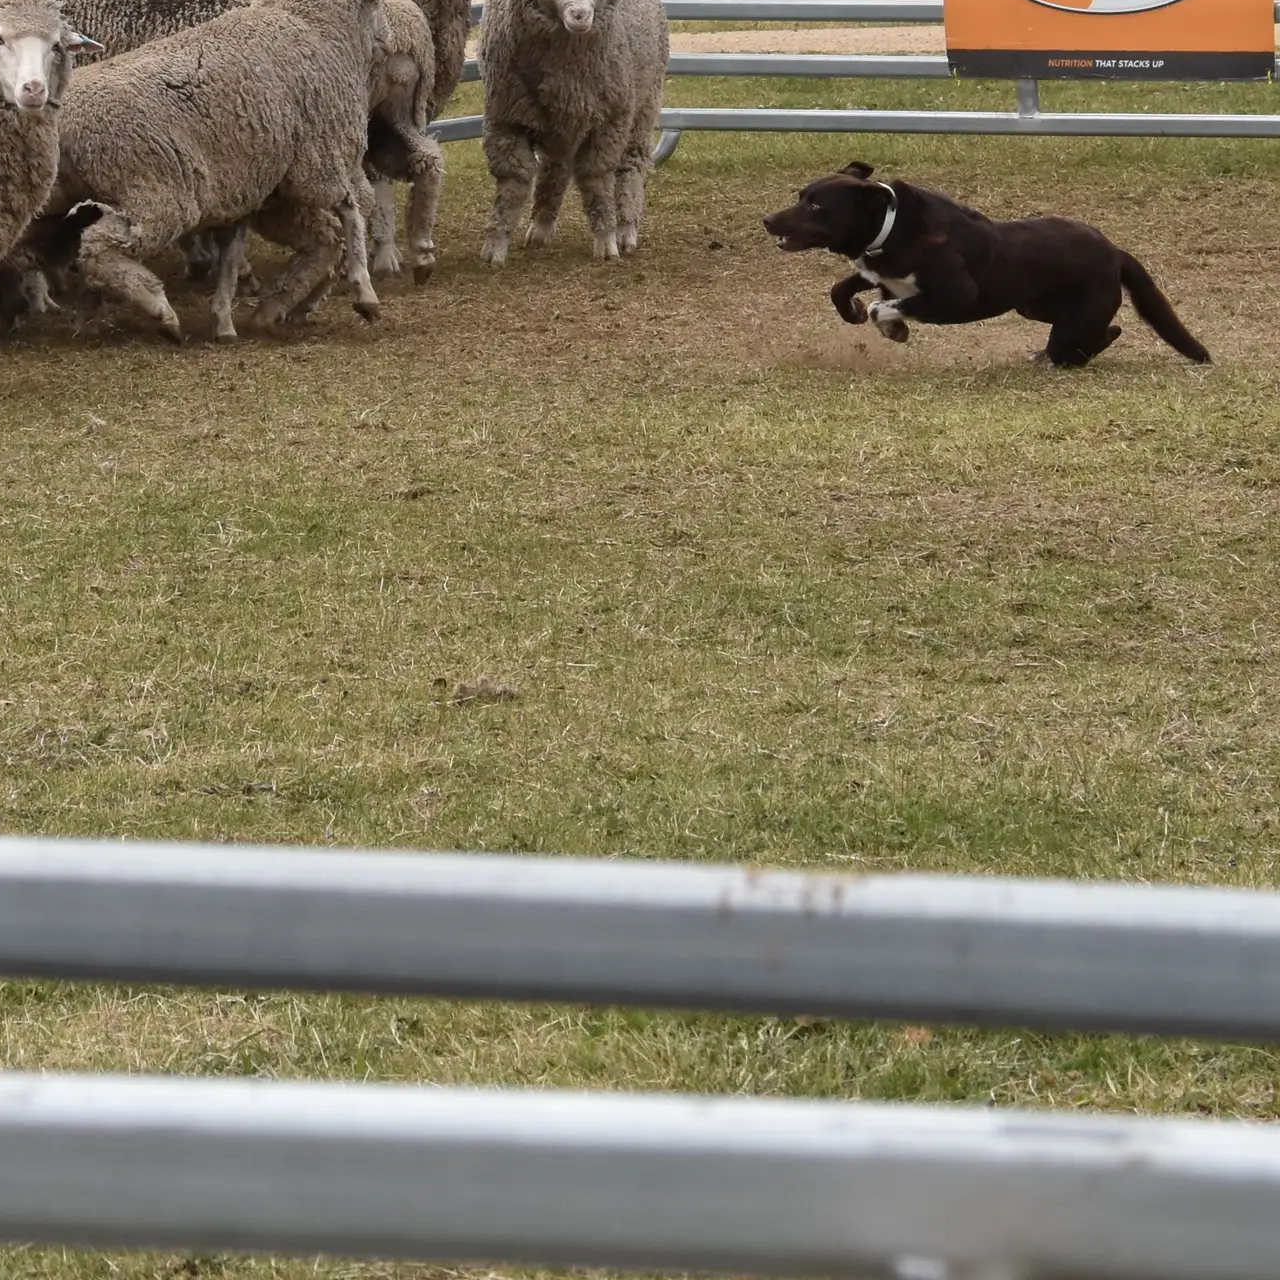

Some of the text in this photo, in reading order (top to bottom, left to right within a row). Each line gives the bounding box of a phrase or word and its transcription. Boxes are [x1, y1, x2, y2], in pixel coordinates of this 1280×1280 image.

[1047, 59, 1165, 68] NUTRITION THAT STACKS UP
